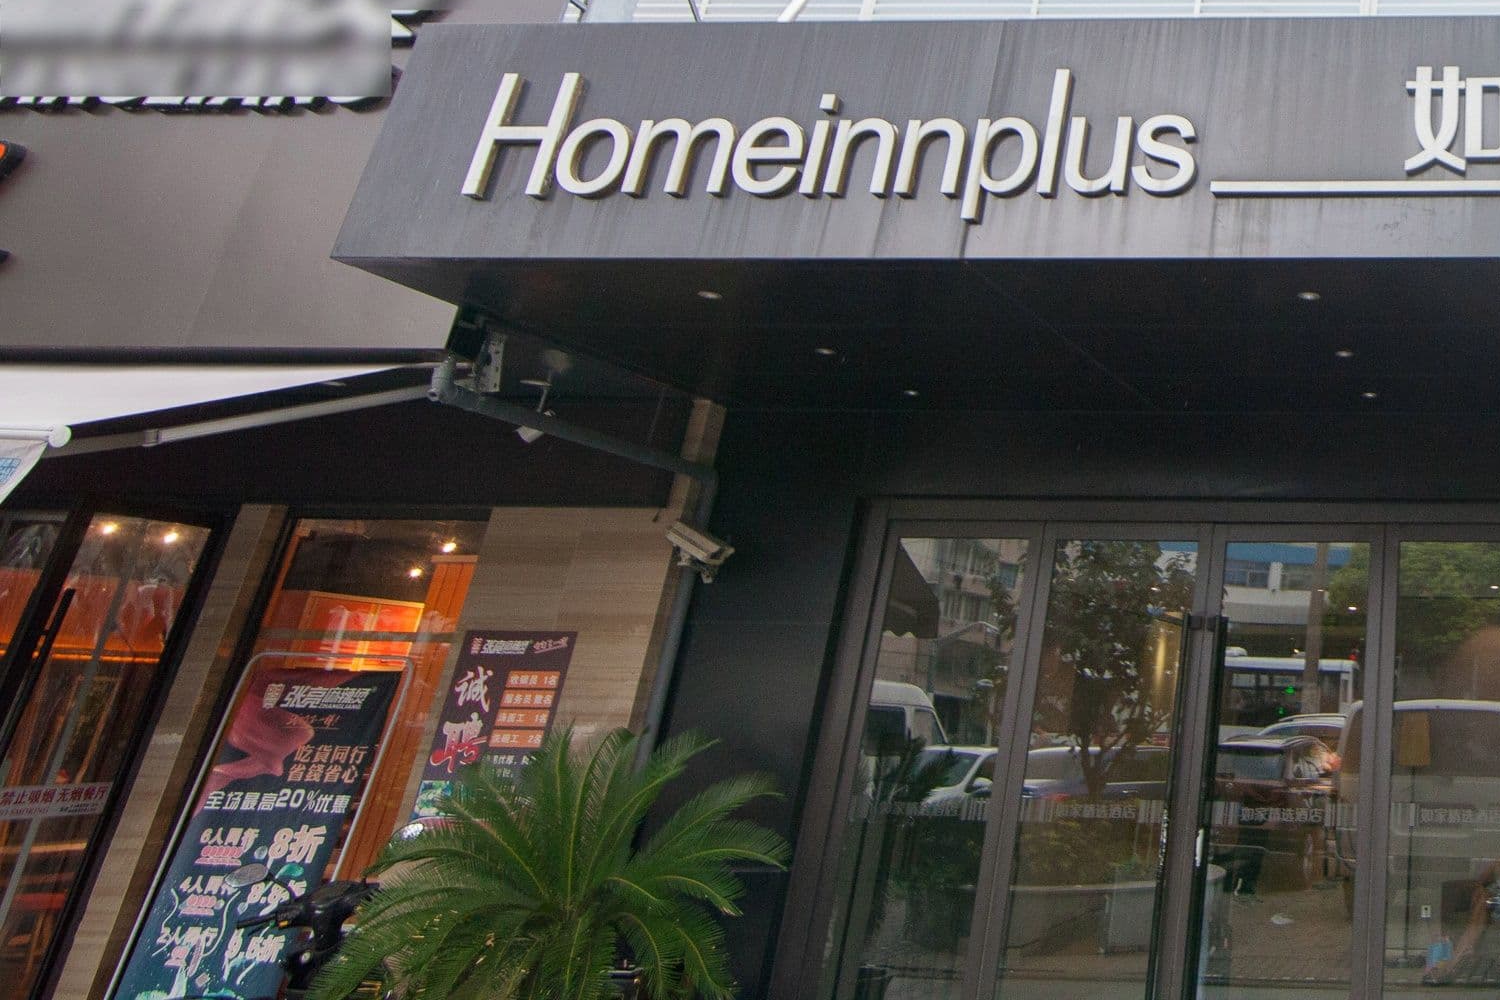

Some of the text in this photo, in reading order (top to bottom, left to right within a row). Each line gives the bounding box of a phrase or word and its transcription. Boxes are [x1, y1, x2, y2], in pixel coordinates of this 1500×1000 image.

[460, 67, 1198, 223] Homeinnplus
[203, 788, 352, 814] 全场最高20%优惠
[267, 824, 327, 864] 8折
